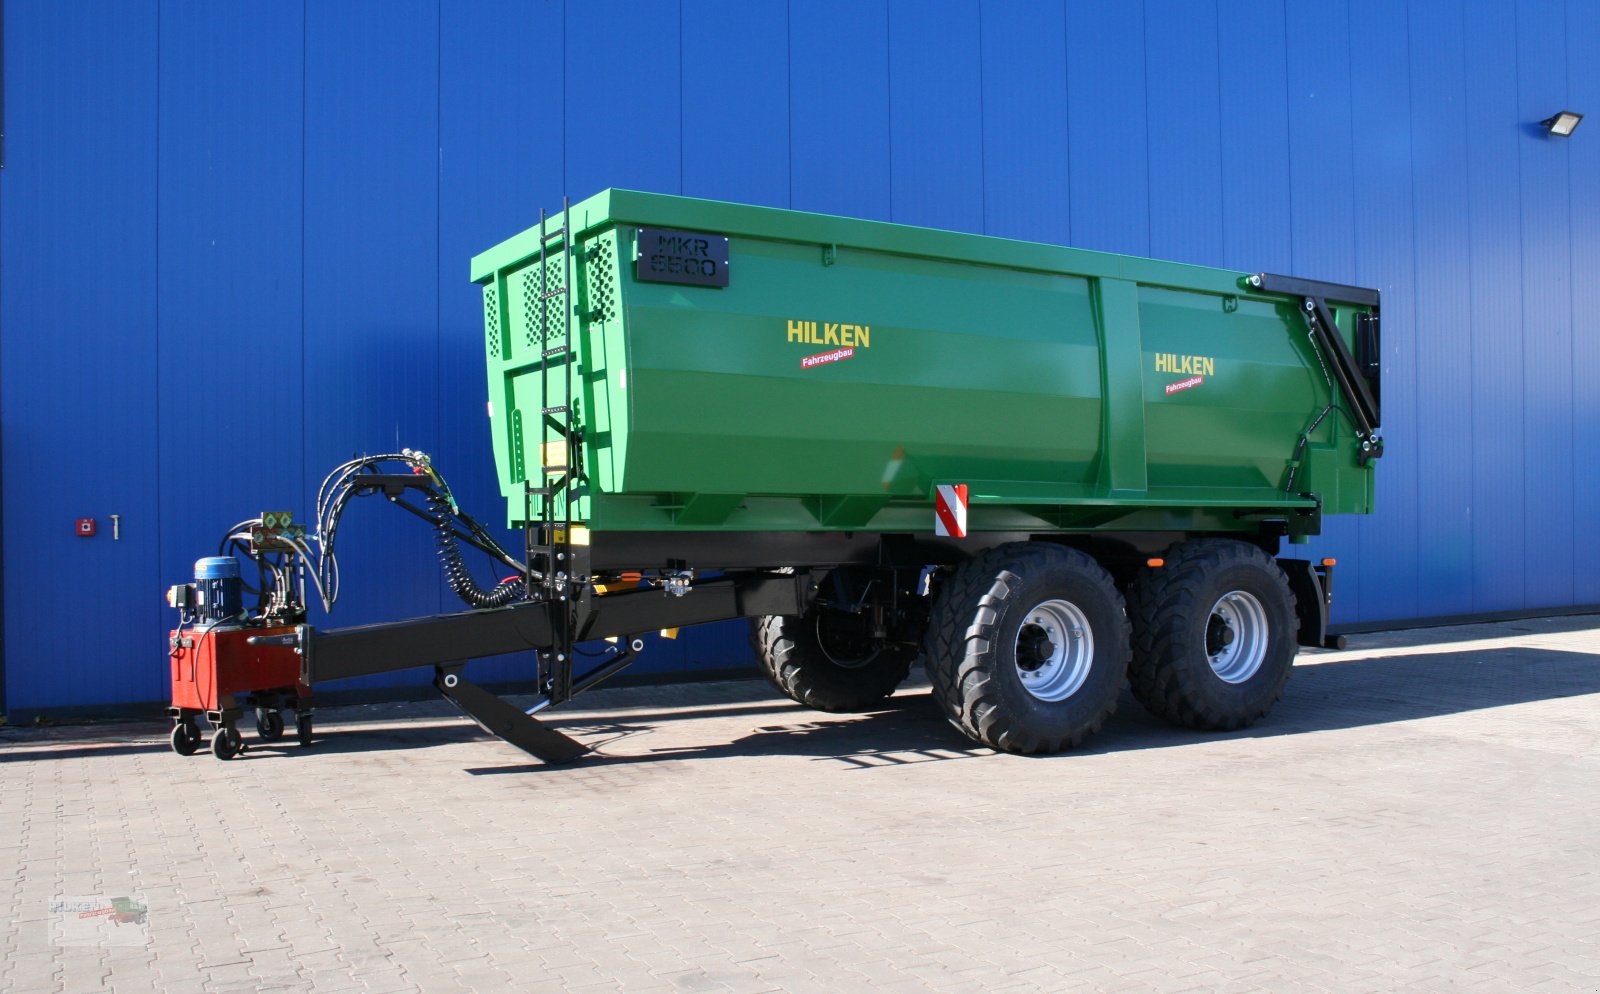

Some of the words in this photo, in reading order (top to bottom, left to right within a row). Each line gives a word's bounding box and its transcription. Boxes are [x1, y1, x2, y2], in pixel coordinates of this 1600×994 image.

[658, 235, 709, 257] MKR
[787, 319, 870, 348] HILKEN
[802, 348, 853, 367] Fahrzeugbau
[1155, 352, 1214, 376] HILKEN
[1165, 377, 1202, 393] Fahrzeugbau
